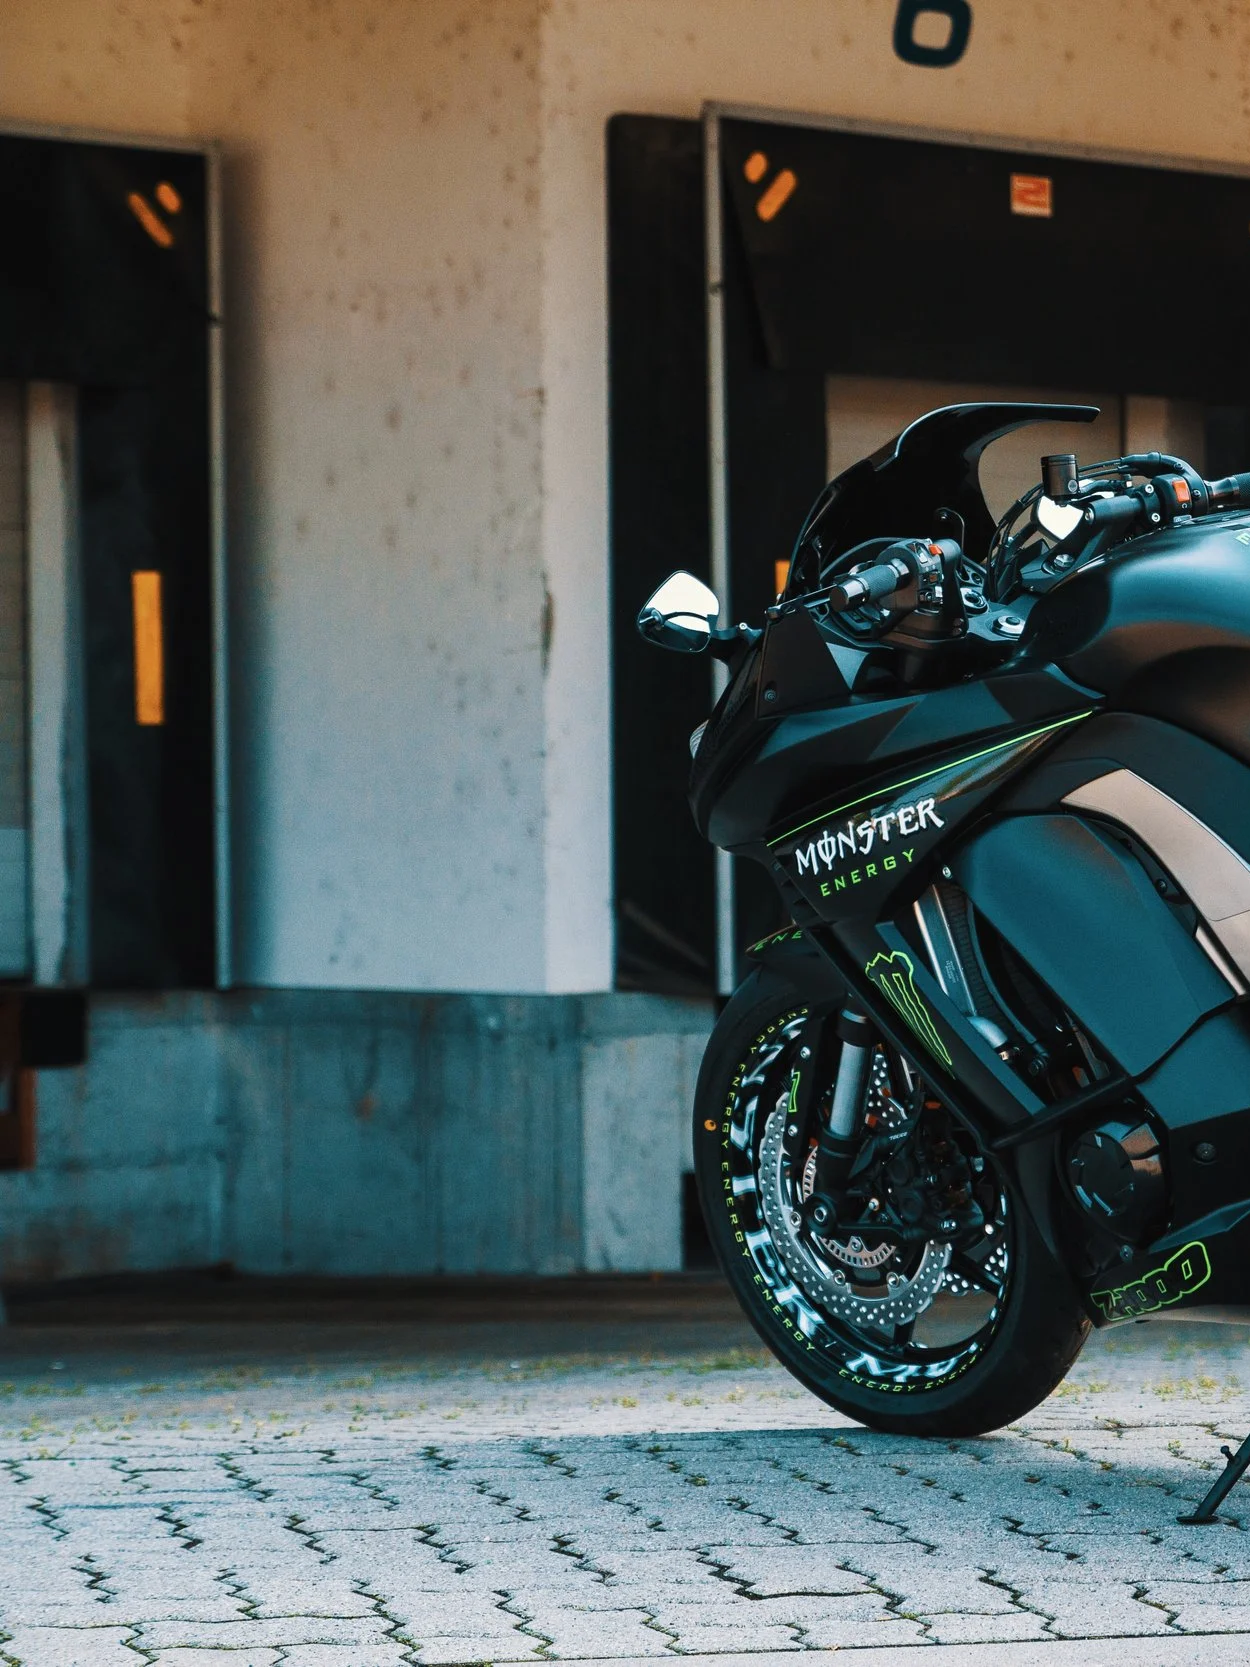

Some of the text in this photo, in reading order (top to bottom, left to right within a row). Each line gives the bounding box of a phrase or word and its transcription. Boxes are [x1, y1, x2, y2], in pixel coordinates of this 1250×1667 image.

[820, 848, 914, 897] ENERGY
[753, 930, 803, 952] ENE
[721, 1161, 751, 1257] ENERGY
[753, 1273, 816, 1351] ENERGY
[838, 1369, 916, 1392] ENERGY
